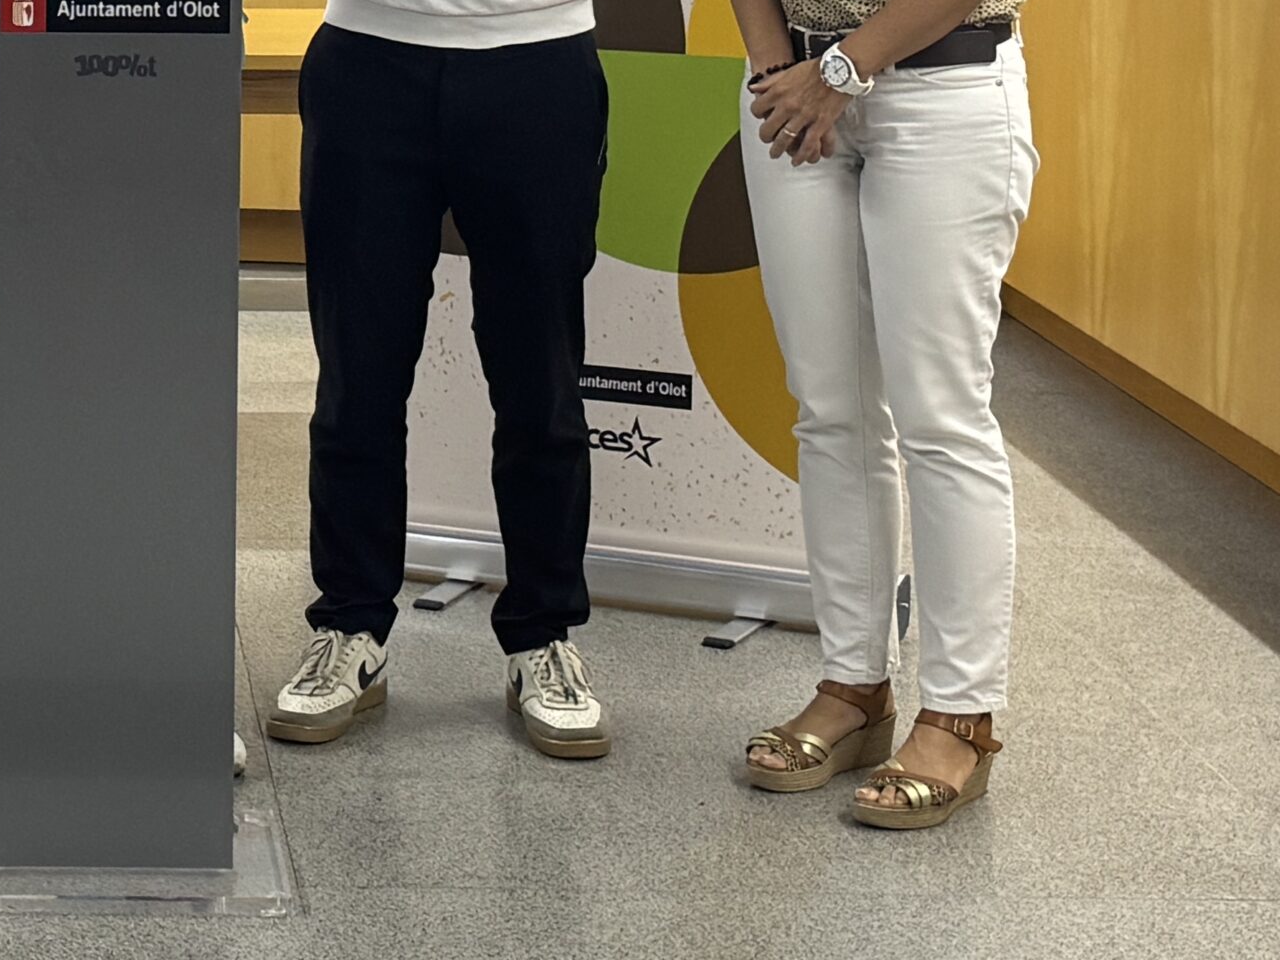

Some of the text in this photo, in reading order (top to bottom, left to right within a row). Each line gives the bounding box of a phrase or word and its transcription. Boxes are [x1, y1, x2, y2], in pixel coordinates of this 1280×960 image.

[57, 0, 221, 21] Ajuntament d'Olot
[646, 380, 687, 398] d'Olot
